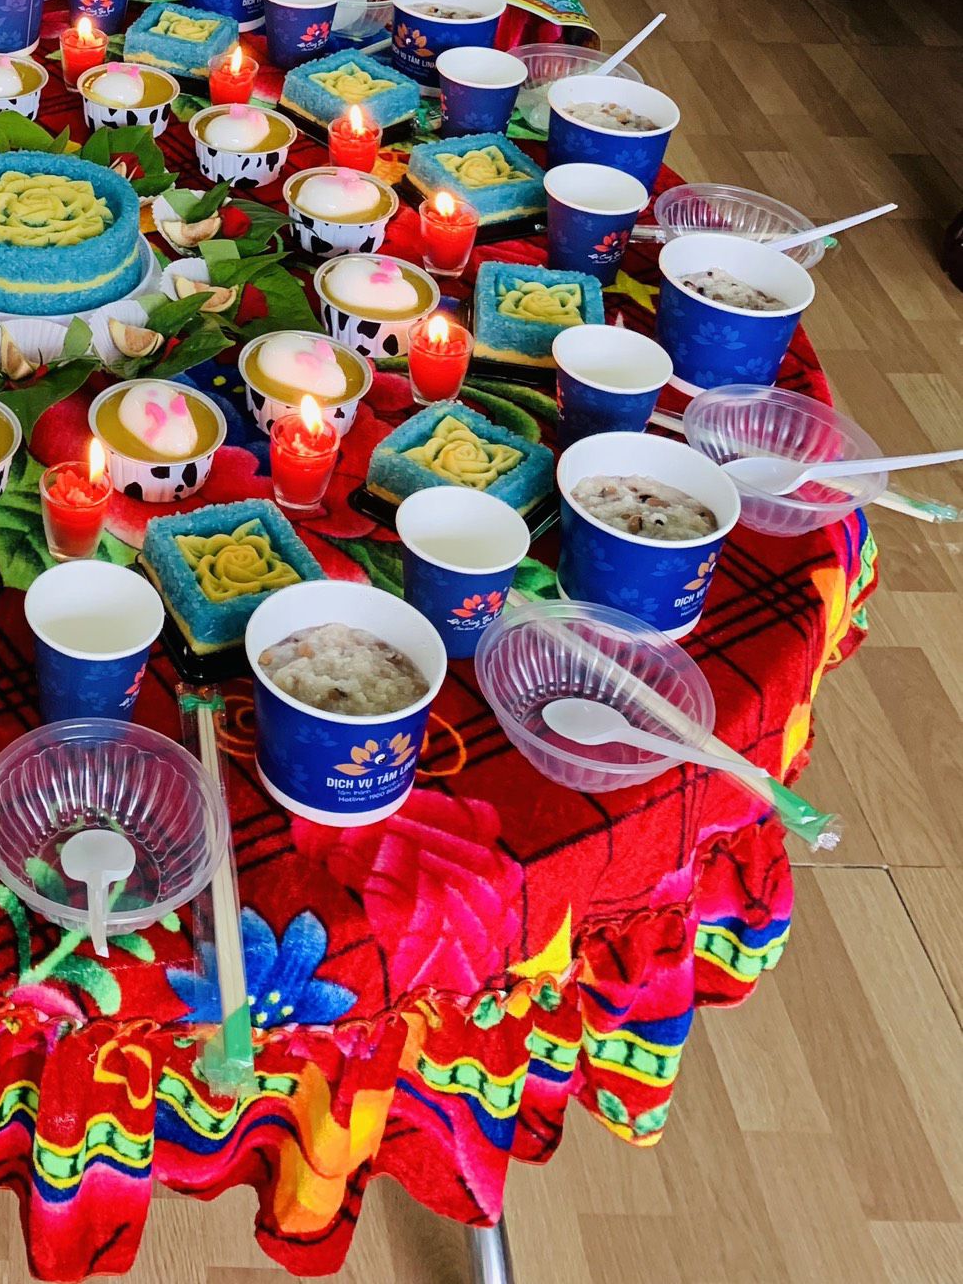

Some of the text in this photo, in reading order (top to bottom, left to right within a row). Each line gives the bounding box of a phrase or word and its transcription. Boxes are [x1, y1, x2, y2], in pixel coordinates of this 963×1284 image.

[407, 55, 420, 65] TÂM
[674, 593, 695, 608] DỊCH
[326, 777, 354, 790] DỊCH
[358, 778, 373, 789] VỤ
[377, 770, 399, 786] TÂM
